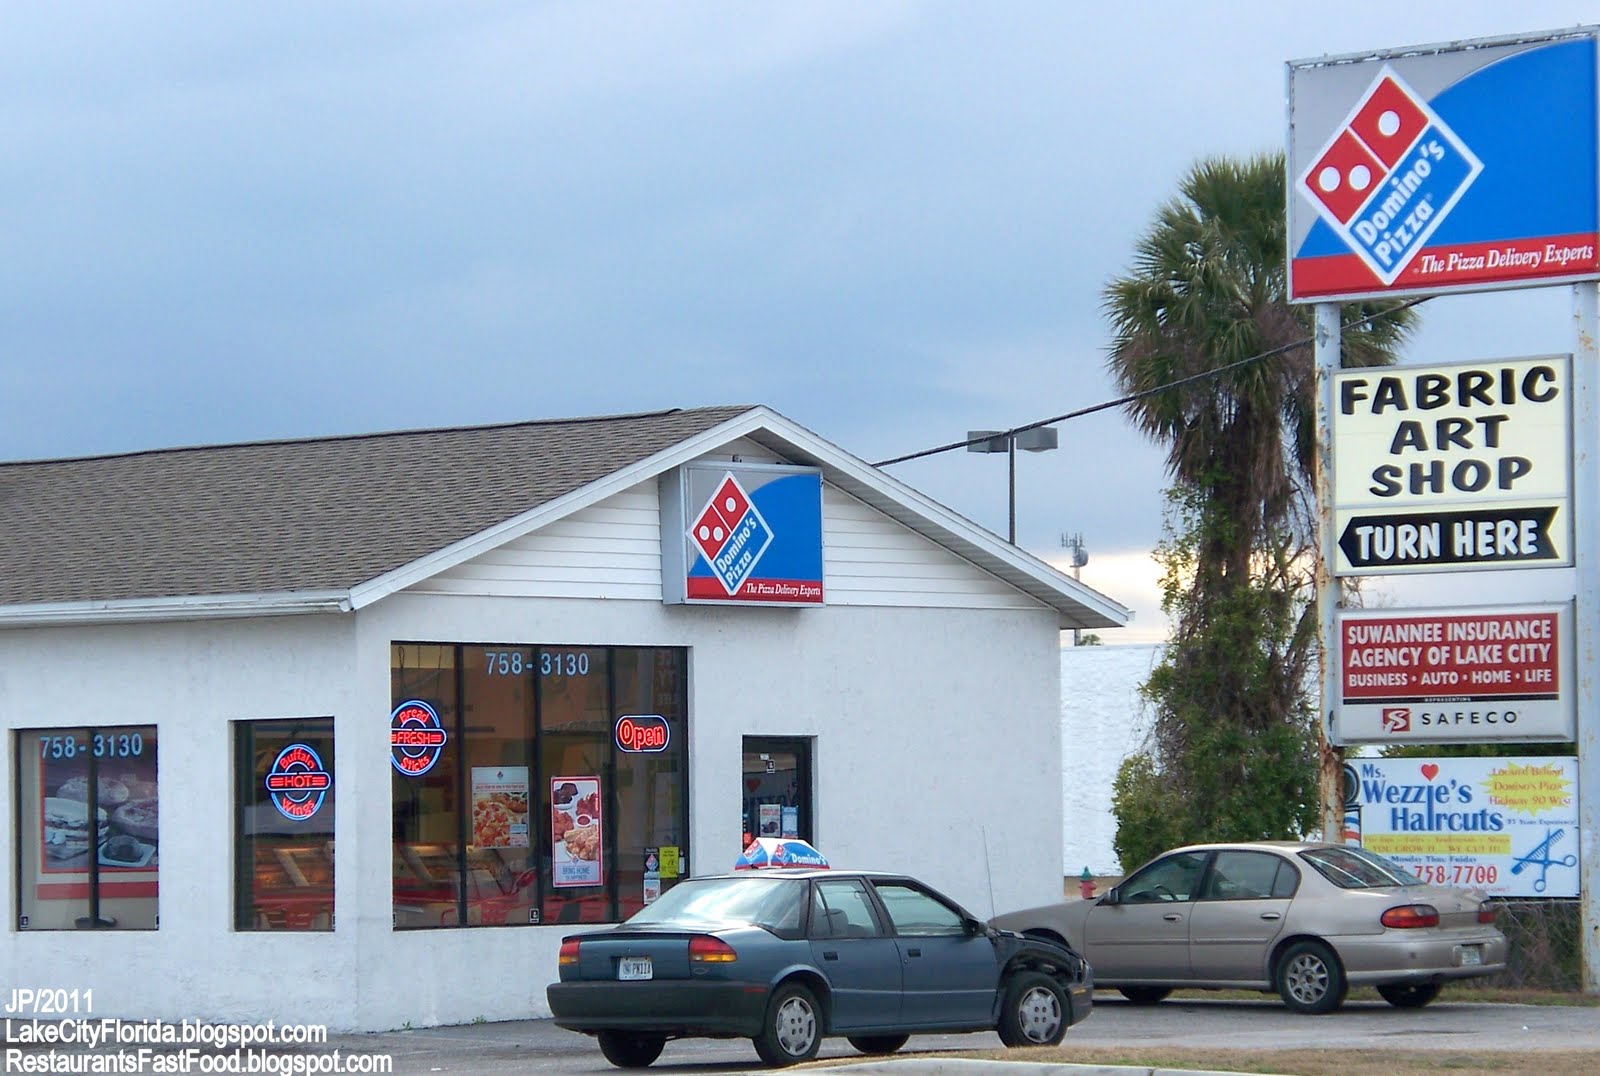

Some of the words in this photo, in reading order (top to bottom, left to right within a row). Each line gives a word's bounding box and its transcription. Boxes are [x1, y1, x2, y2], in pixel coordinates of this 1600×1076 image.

[1355, 139, 1446, 248] Domino's
[1374, 198, 1434, 266] Pizza
[1421, 254, 1445, 274] The
[1447, 252, 1485, 272] Pizza
[1487, 247, 1542, 269] Delivery
[1544, 243, 1593, 265] Experts
[1341, 366, 1560, 415] FABRIC
[1390, 414, 1510, 455] ART
[1369, 456, 1533, 497] SHOP
[716, 516, 757, 574] Domino's
[1355, 521, 1441, 561] TURN
[1453, 519, 1538, 557] HERE
[725, 551, 753, 587] Pizza
[747, 582, 757, 594] The
[758, 583, 774, 594] Pizza
[775, 583, 799, 597] Delivery
[800, 584, 821, 598] Experts
[1348, 623, 1443, 645] SUWANNEE
[1448, 619, 1551, 642] INSURANCE
[1349, 646, 1423, 668] AGENCY
[1427, 646, 1450, 666] OF
[1455, 644, 1502, 665] LAKE
[1507, 643, 1551, 663] CITY
[1349, 672, 1408, 687] BUSINESS
[1421, 671, 1459, 685] AUTO
[1472, 670, 1512, 684] HOME
[1524, 669, 1552, 682] LIFE
[398, 708, 430, 724] Bread
[1421, 711, 1518, 725] SAFECO
[397, 732, 430, 744] FRESH
[619, 719, 665, 750] Open
[279, 748, 316, 769] Buffalo
[401, 755, 430, 771] Sticks
[284, 775, 313, 788] HOT
[1362, 764, 1386, 779] Ms.
[1362, 779, 1473, 804] Wezzie's
[1532, 796, 1546, 804] 90
[282, 797, 315, 816] Wings
[1391, 806, 1504, 832] Haircuts
[791, 852, 826, 866] Domino's
[1414, 865, 1498, 884] 758-7700
